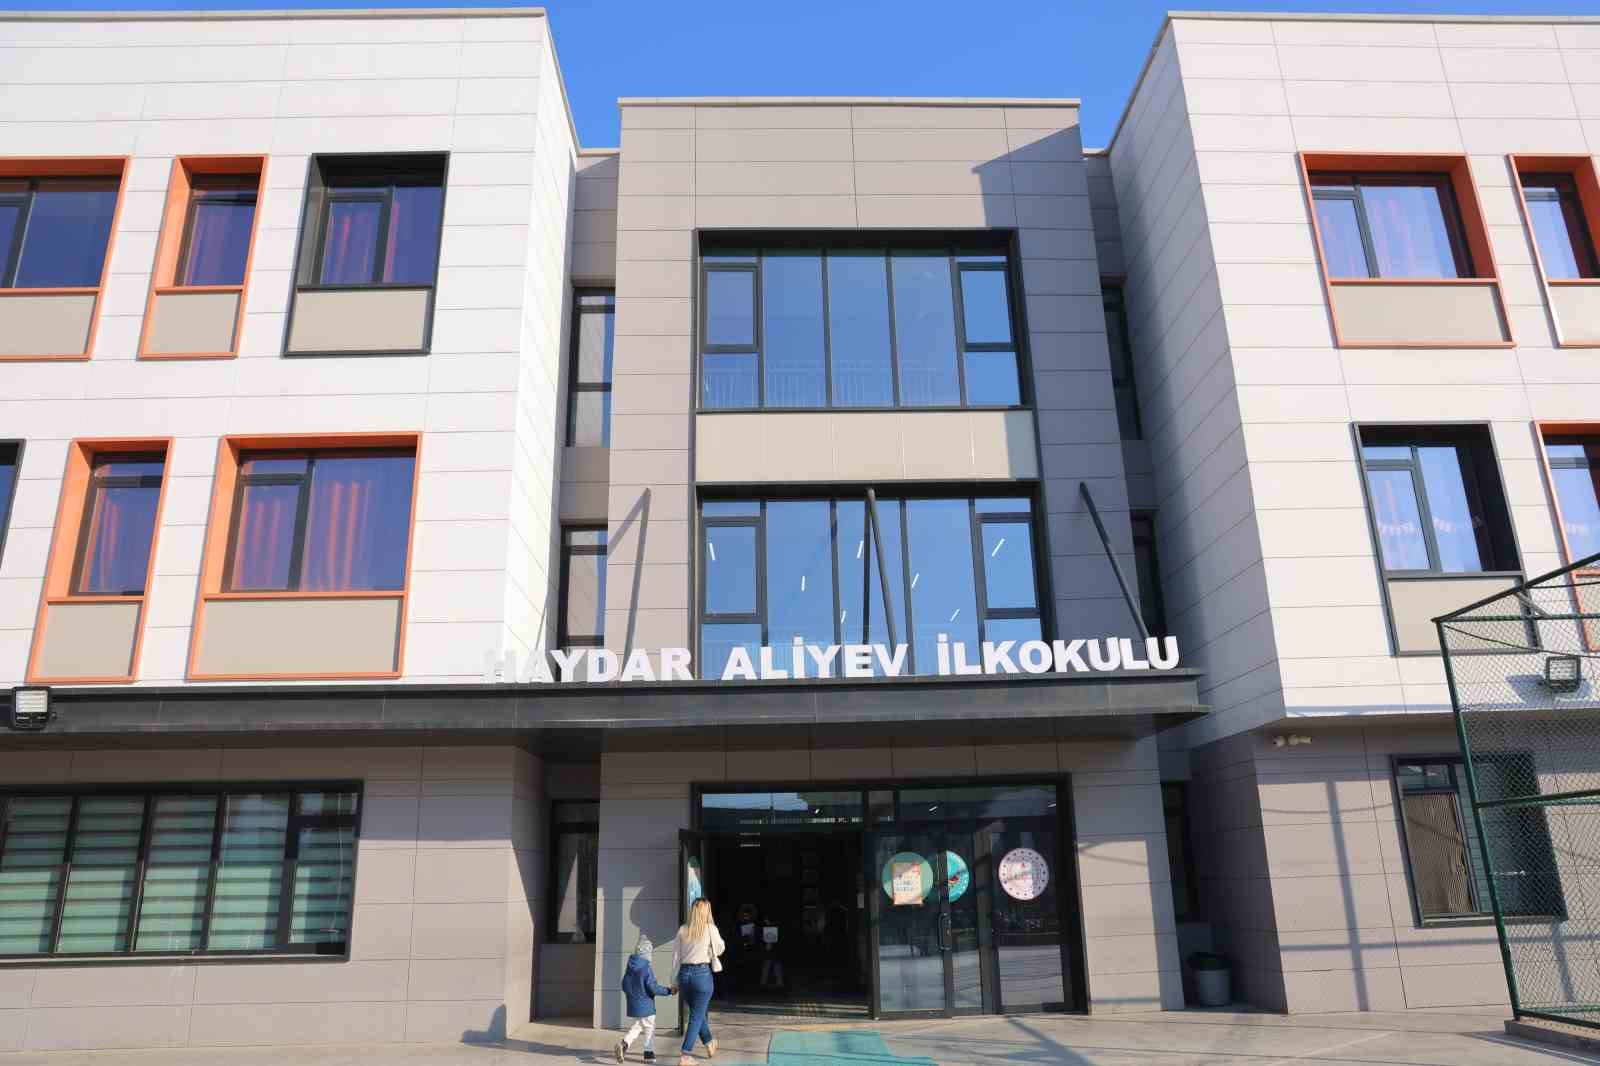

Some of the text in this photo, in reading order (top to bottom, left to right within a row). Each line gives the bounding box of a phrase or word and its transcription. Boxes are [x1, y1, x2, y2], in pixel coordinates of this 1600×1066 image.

[483, 633, 1180, 684] HAYDAR ALİYEV İLKOKULU
